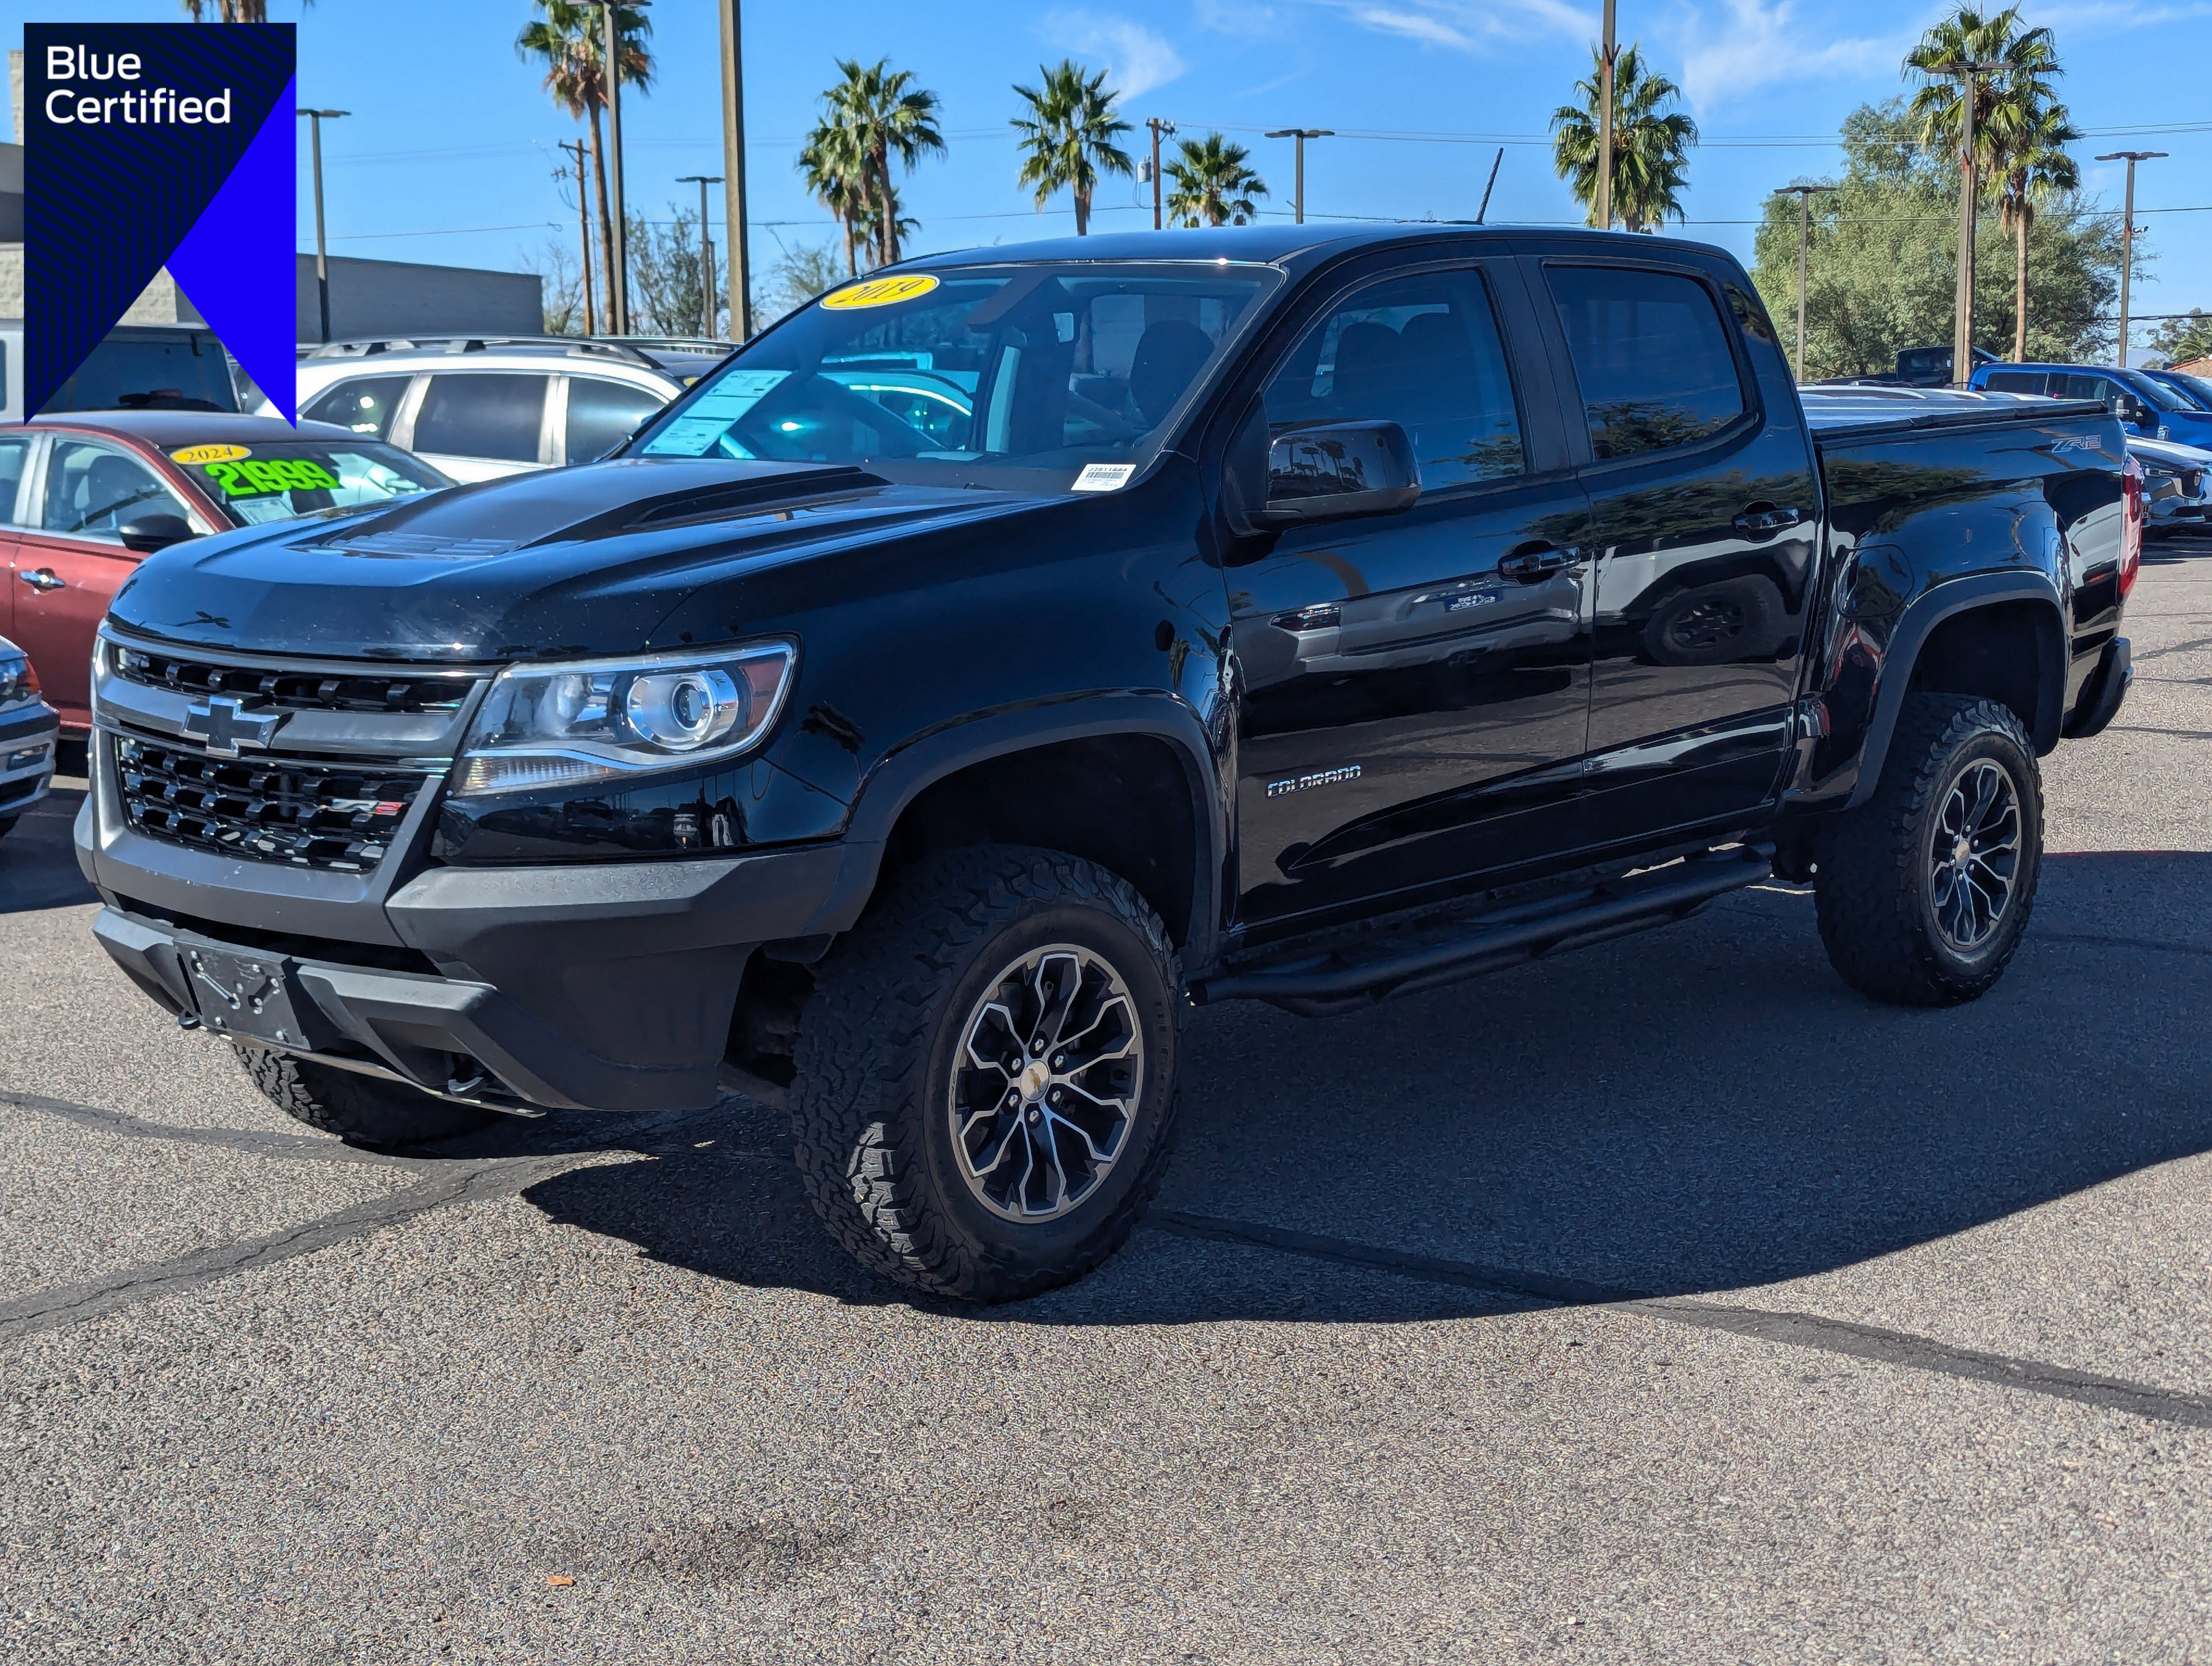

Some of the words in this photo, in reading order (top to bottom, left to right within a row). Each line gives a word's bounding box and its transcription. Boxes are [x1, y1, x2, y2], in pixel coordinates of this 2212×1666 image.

[833, 279, 924, 304] 2019
[185, 446, 234, 462] 2024
[2051, 434, 2101, 453] ZR2
[205, 460, 342, 496] 21999
[1267, 765, 1361, 797] COLORADO
[328, 798, 404, 816] ZR2
